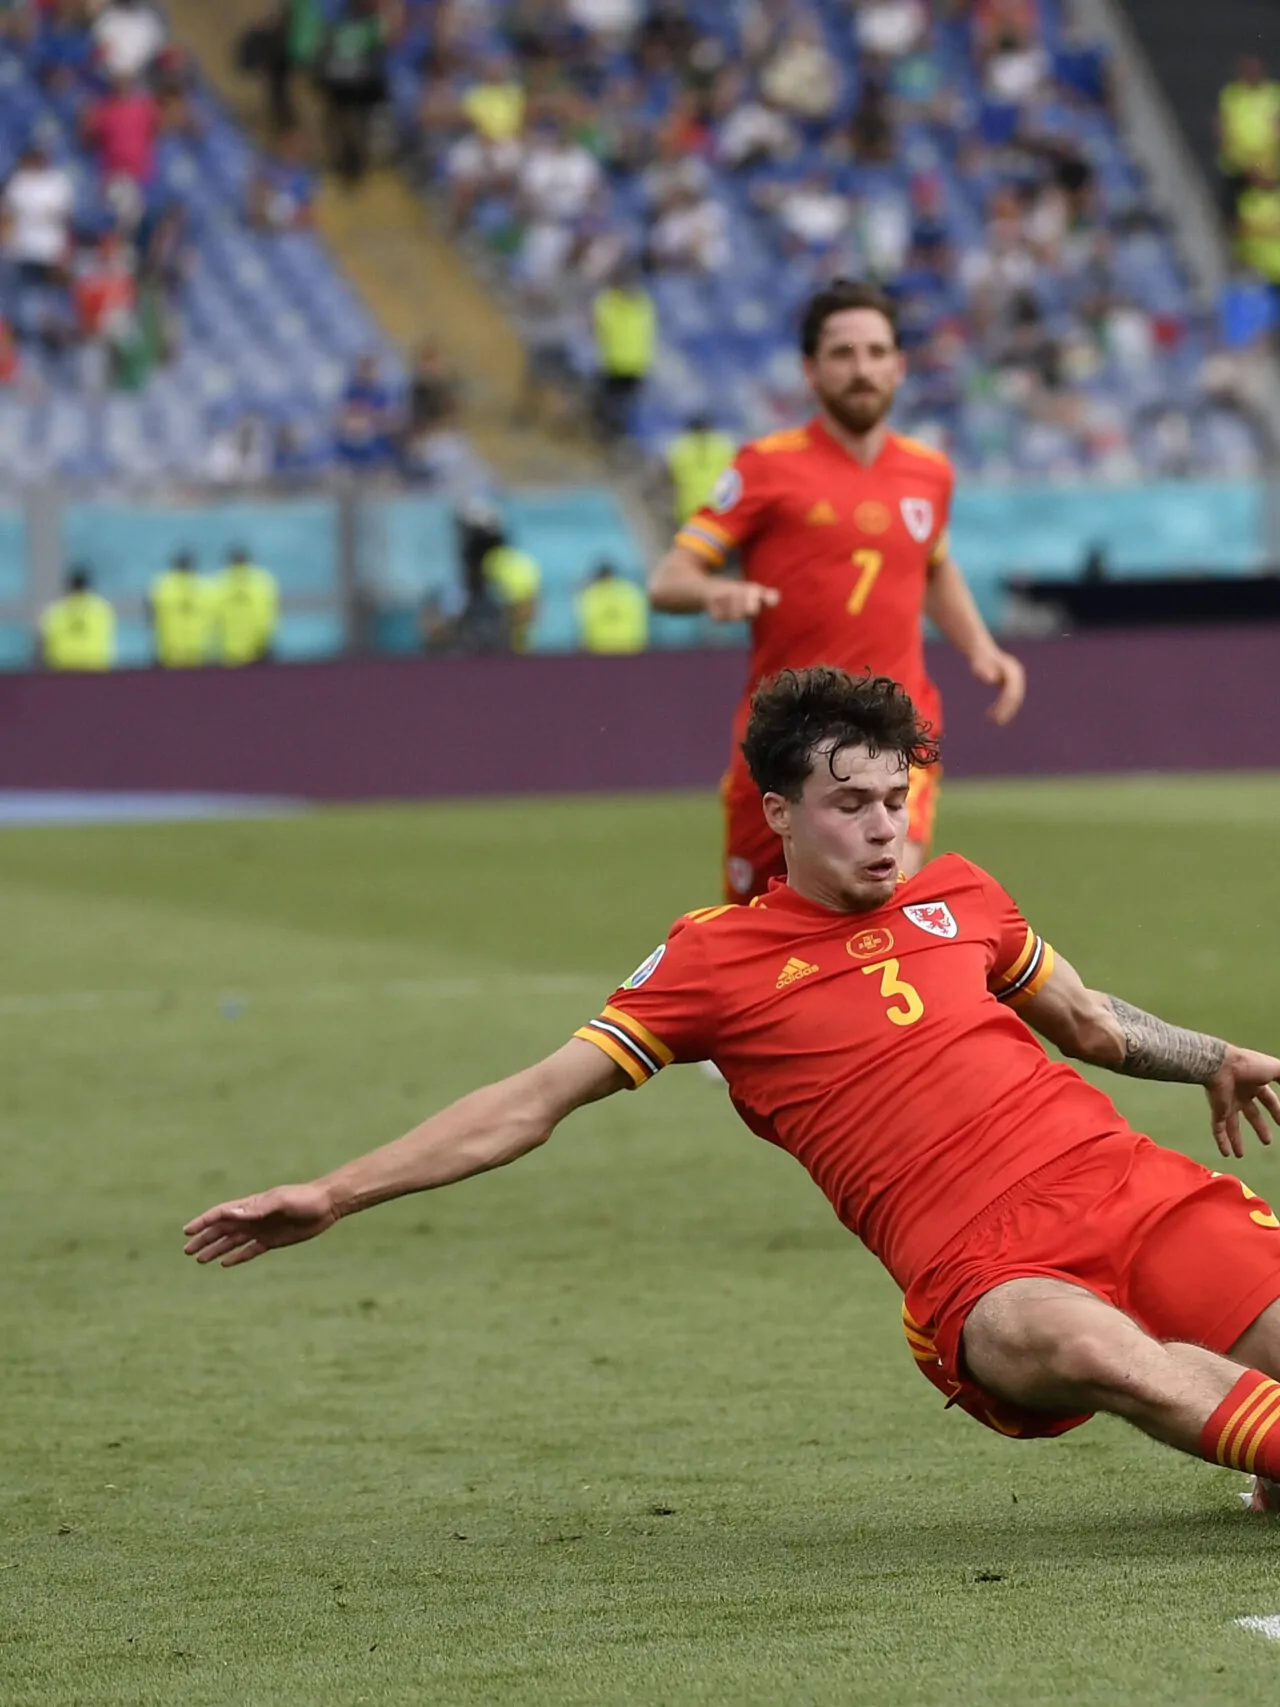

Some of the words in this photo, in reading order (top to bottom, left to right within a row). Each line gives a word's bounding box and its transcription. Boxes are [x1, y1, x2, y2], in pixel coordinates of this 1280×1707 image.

[846, 549, 882, 615] 7
[775, 964, 820, 989] adidas
[861, 958, 924, 1026] 3
